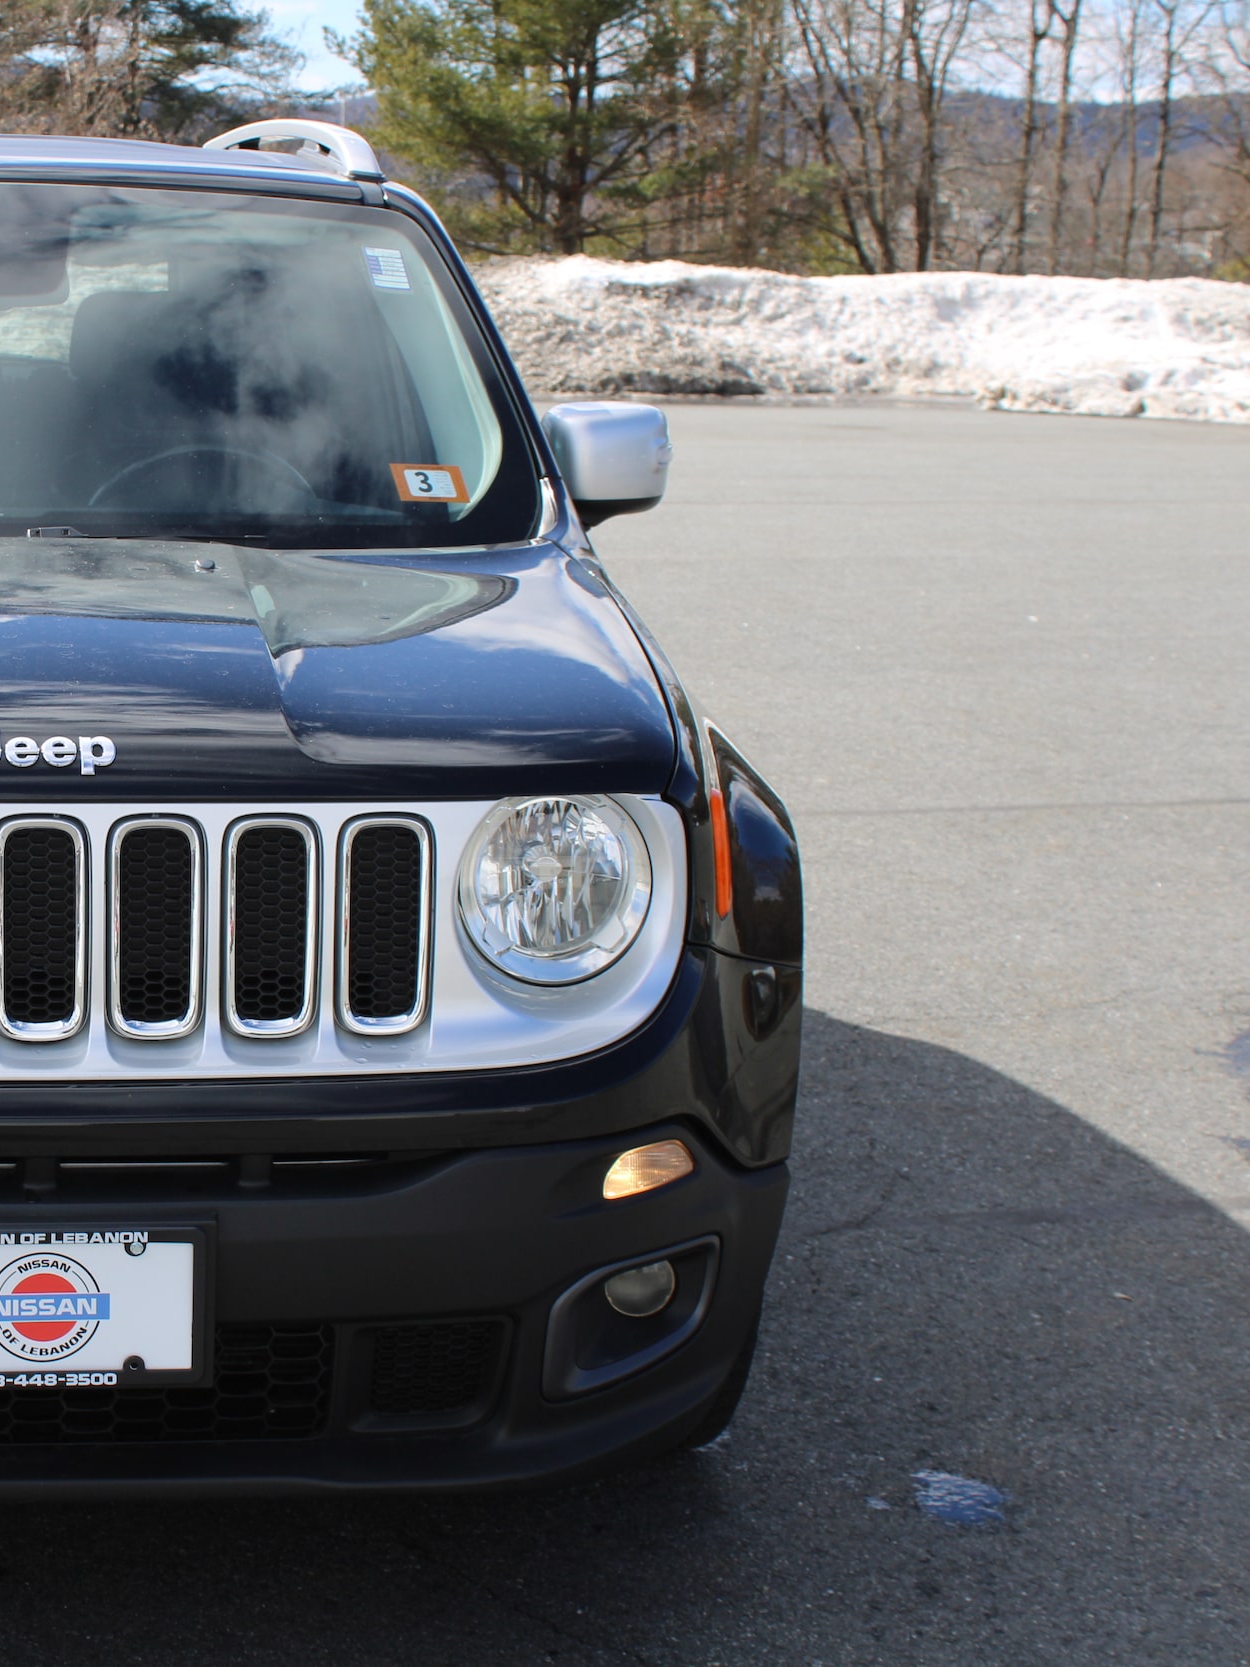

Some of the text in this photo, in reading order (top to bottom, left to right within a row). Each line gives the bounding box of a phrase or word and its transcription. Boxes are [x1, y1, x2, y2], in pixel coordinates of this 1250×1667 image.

[414, 471, 434, 493] 3
[19, 1233, 47, 1245] OF
[50, 1231, 149, 1244] LEBANON
[17, 1259, 71, 1274] NISSAN
[1, 1327, 88, 1356] OF LEBANON
